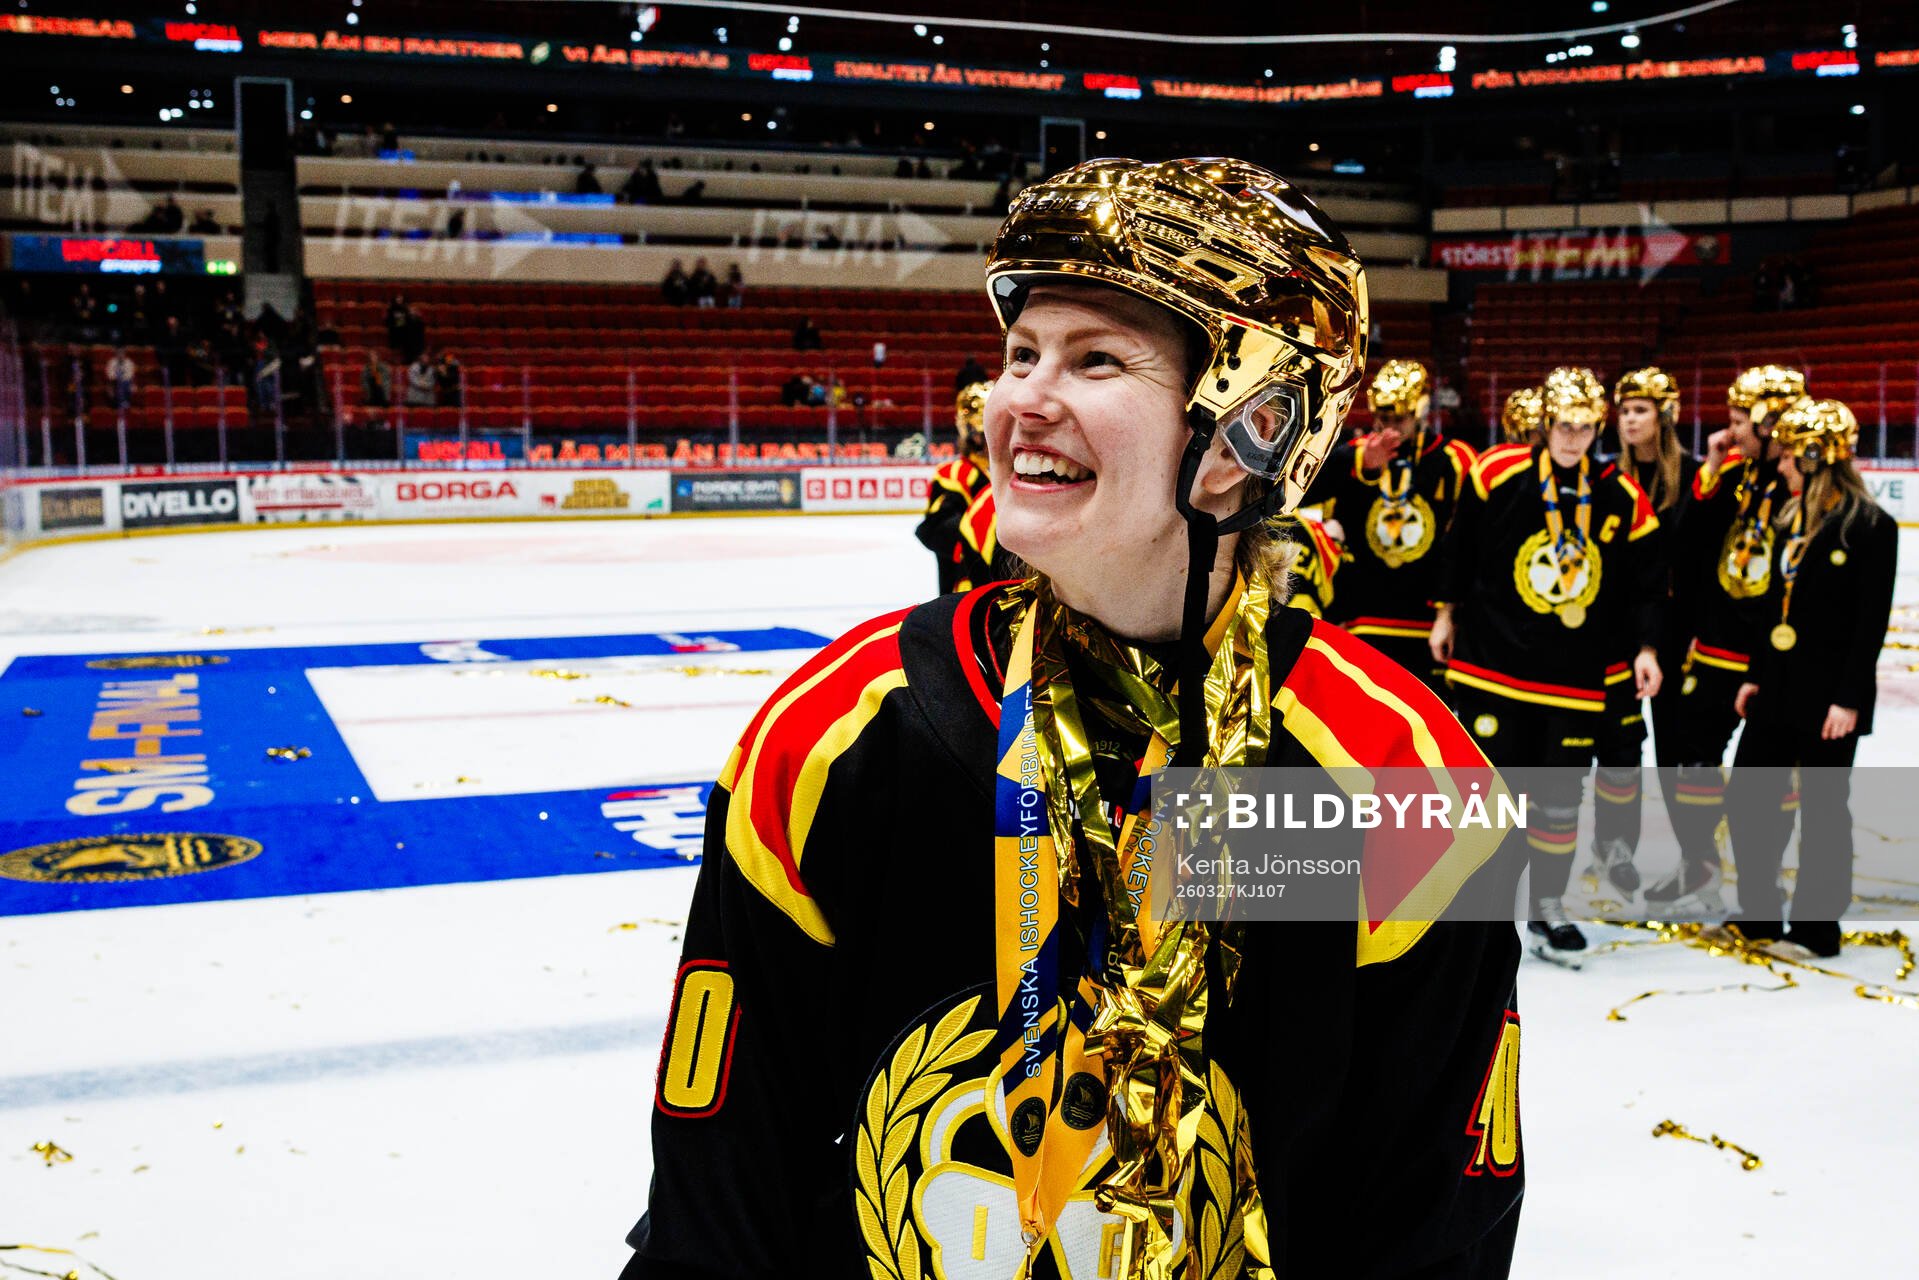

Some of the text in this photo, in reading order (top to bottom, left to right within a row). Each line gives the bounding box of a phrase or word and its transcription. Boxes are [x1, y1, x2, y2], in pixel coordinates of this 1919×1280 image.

[123, 489, 236, 519] DIVELLO
[396, 480, 517, 501] BORGA
[1599, 514, 1621, 544] C
[65, 673, 215, 816] SM-FINAL
[1095, 740, 1121, 753] 1912
[1018, 957, 1043, 1079] SVENSKA
